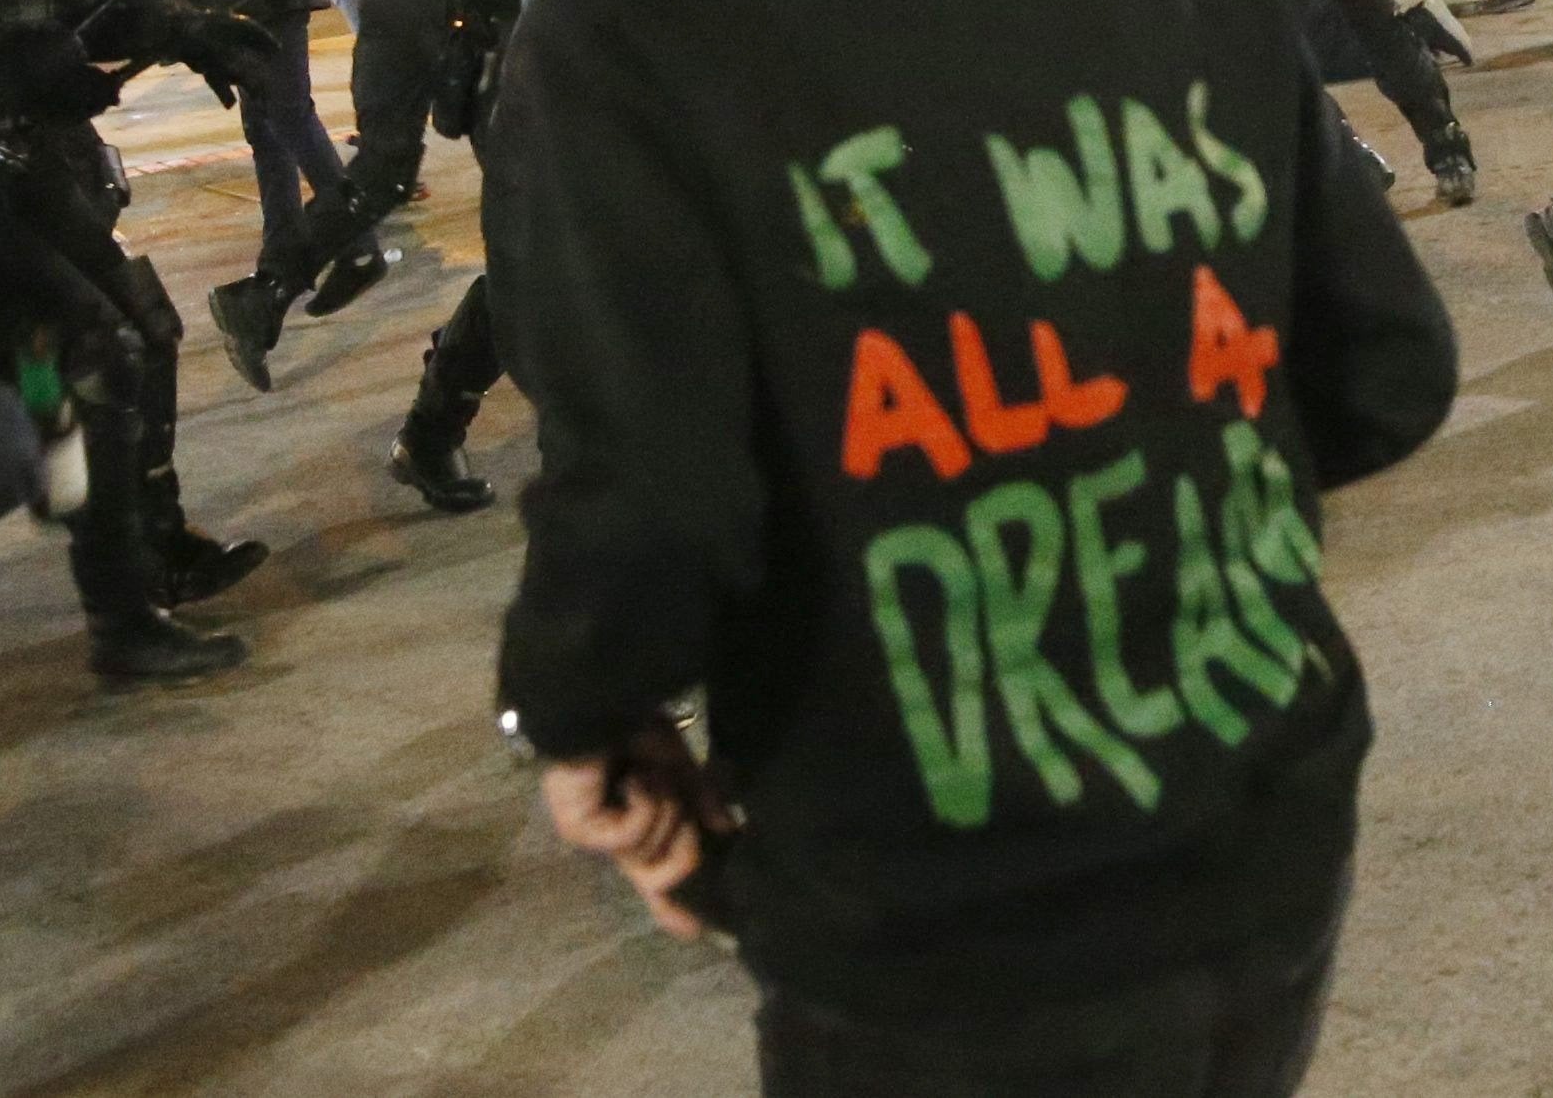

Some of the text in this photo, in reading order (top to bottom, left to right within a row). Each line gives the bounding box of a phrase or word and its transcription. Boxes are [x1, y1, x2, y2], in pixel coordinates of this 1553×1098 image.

[788, 79, 1269, 291] IT WAS
[841, 310, 1129, 481] ALL
[865, 419, 1324, 830] DREAM
